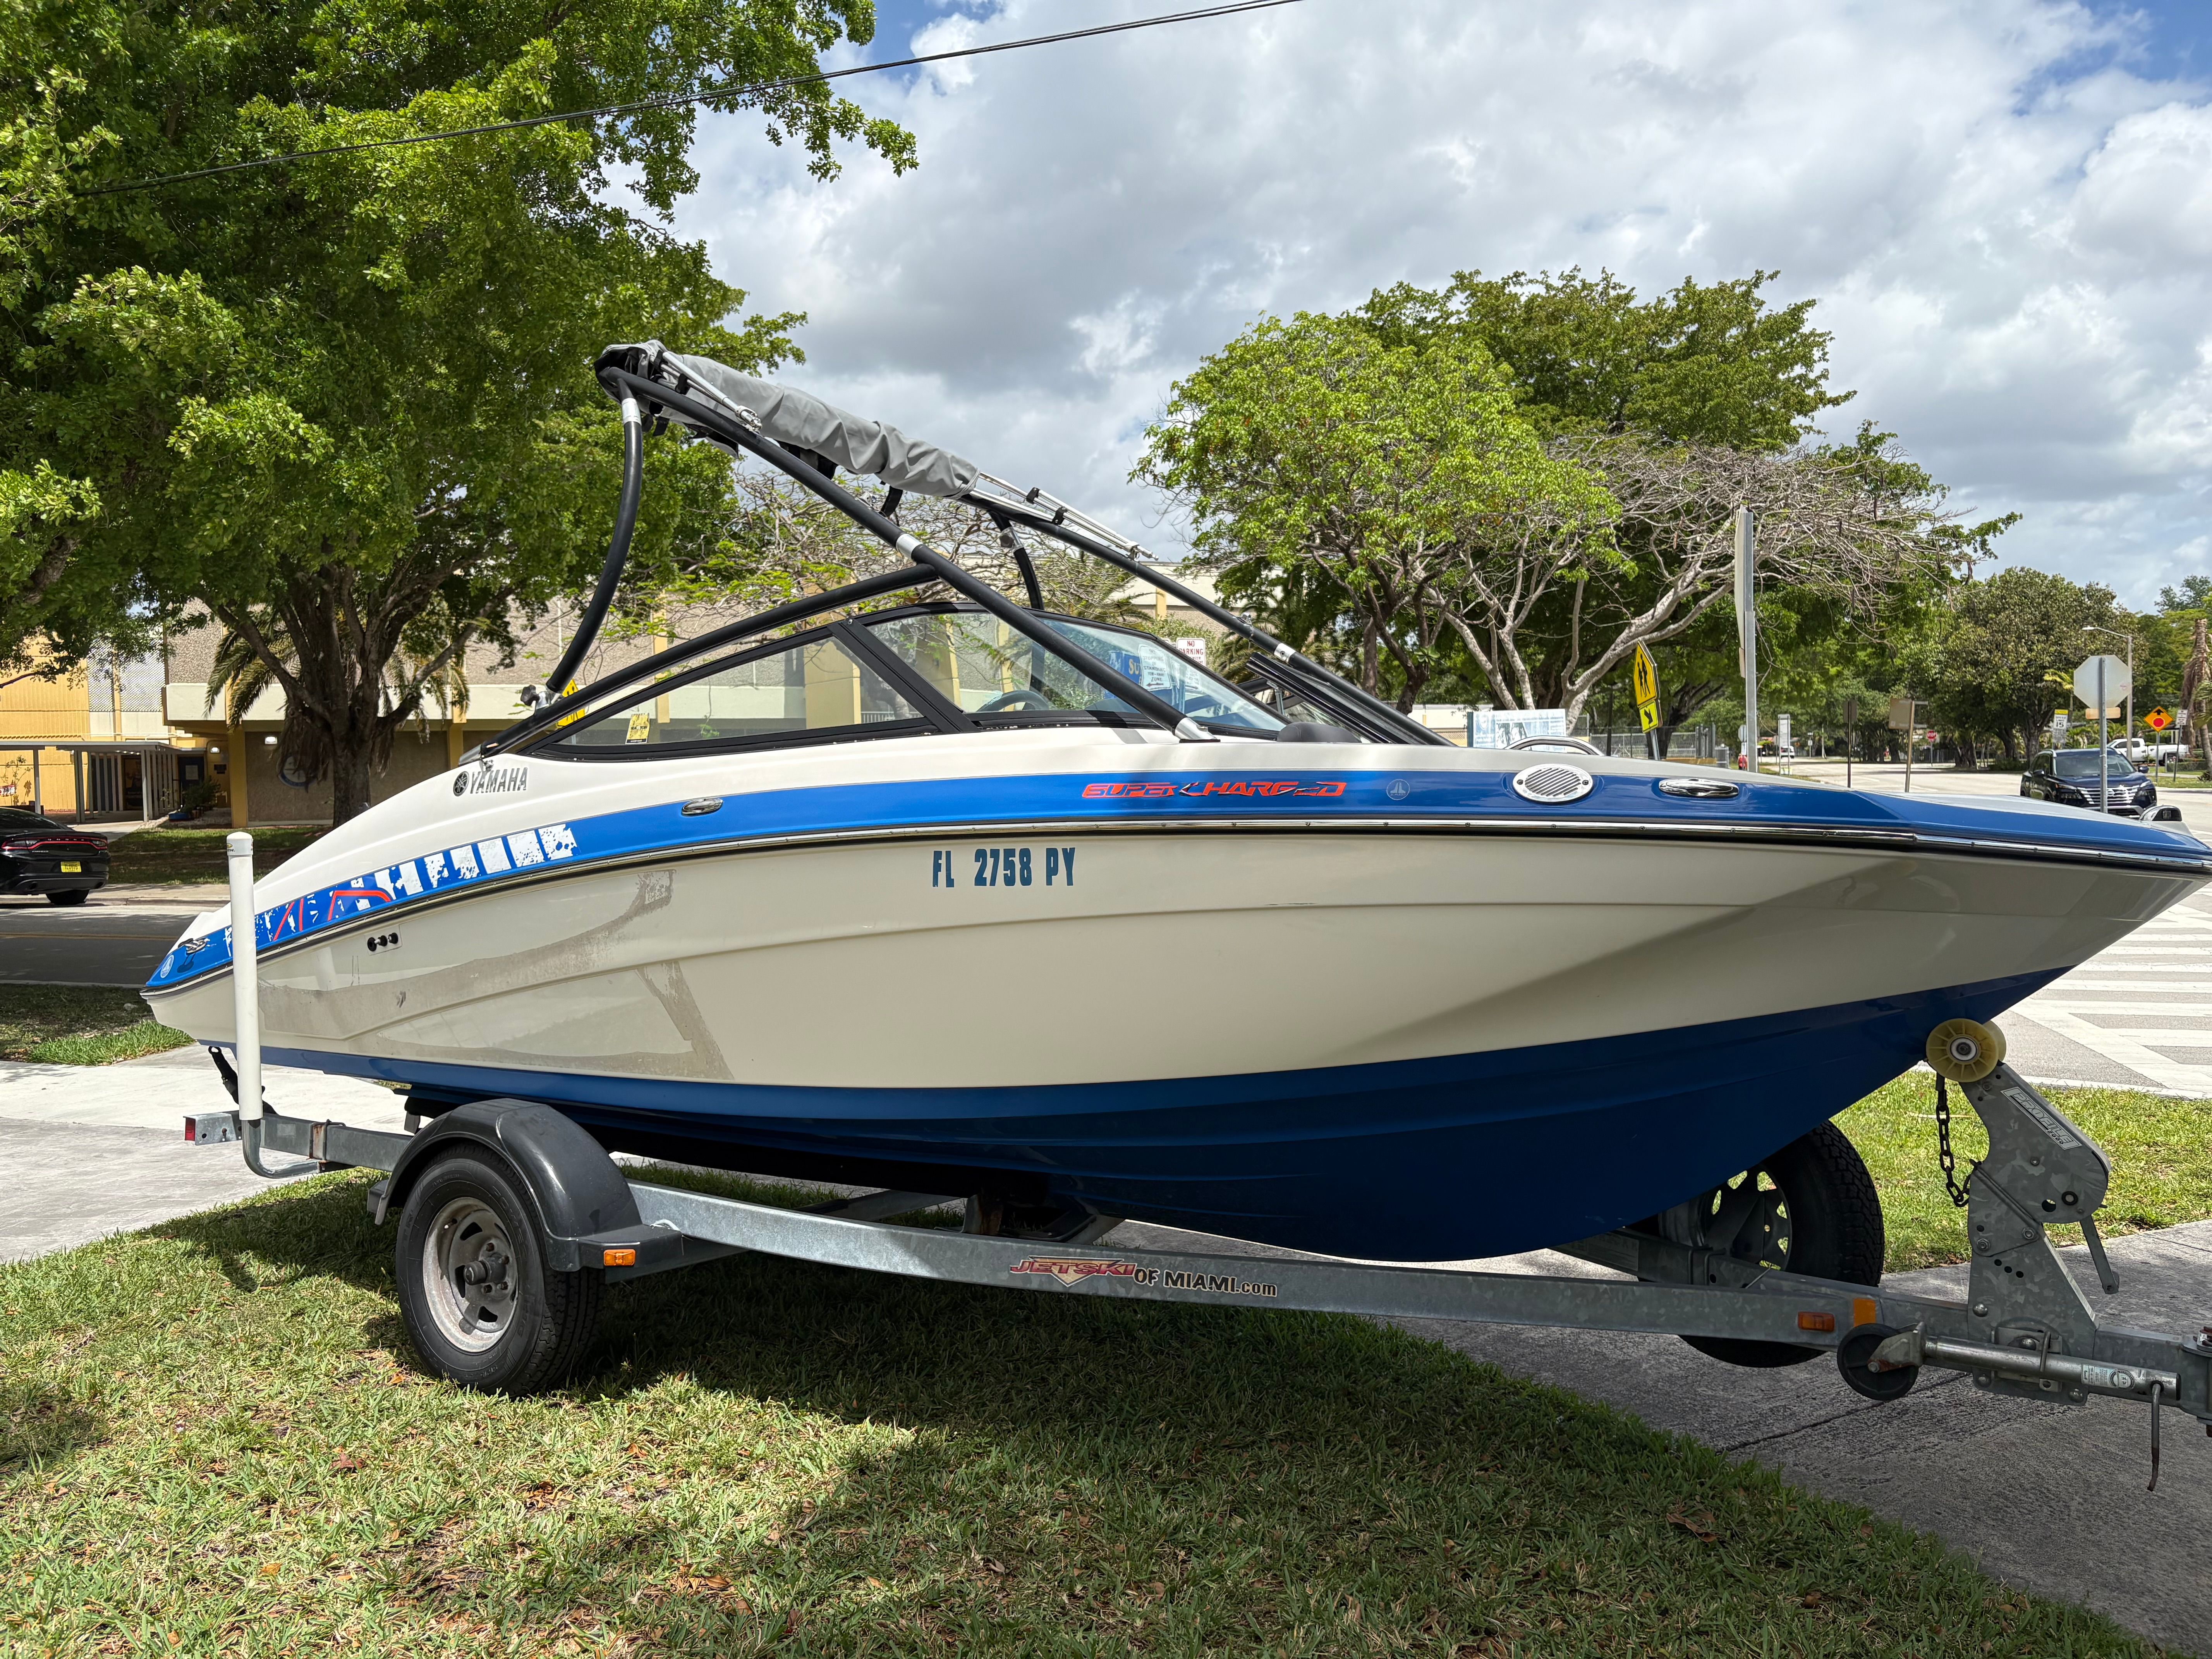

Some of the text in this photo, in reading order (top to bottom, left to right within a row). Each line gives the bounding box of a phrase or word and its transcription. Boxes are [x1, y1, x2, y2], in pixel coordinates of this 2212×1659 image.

[470, 767, 528, 794] YAMAHA
[933, 847, 1075, 888] FL 2758 PY
[2012, 1092, 2074, 1144] PROFILE
[2047, 1130, 2064, 1145] 2000
[1135, 1269, 1159, 1285] OF
[1164, 1272, 1277, 1296] MIAMI.com
